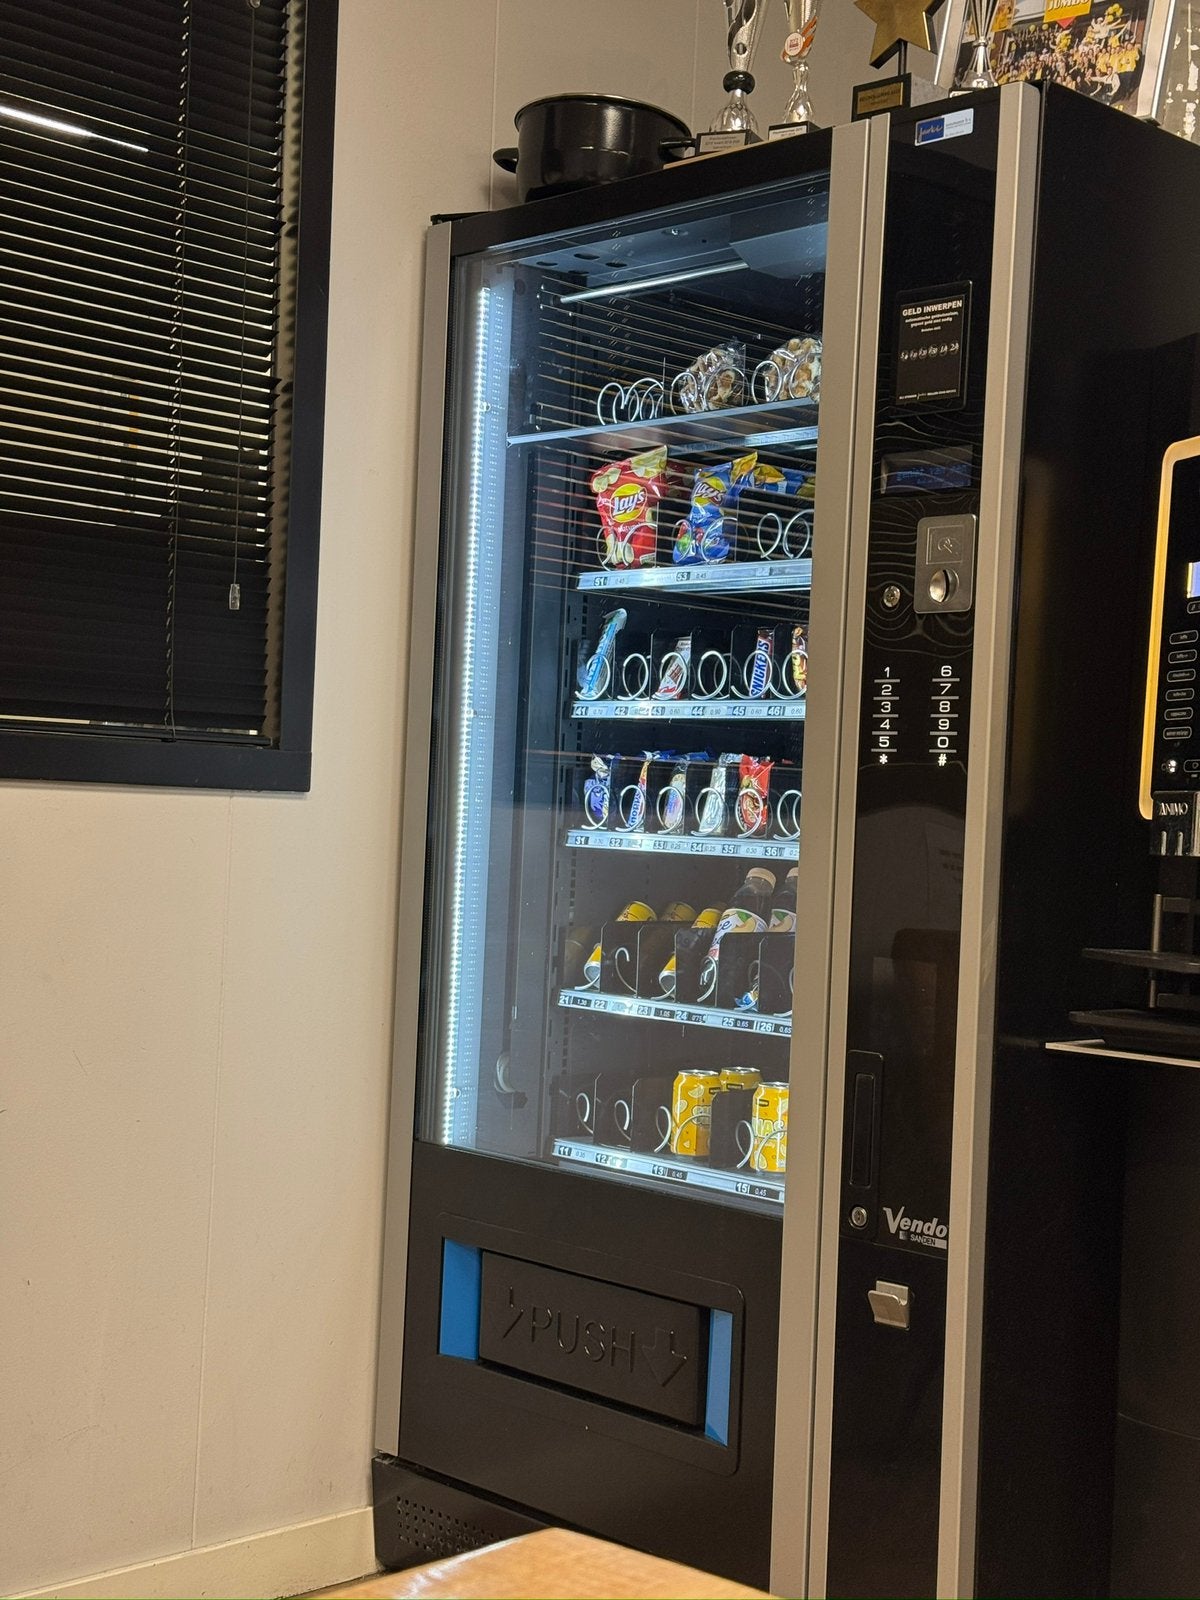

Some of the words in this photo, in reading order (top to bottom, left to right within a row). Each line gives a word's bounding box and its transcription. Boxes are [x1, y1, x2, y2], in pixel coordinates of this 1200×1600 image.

[902, 306, 922, 316] GELD
[923, 299, 963, 313] INWERPEN
[612, 489, 645, 516] Lay's
[749, 639, 770, 697] SNICKES
[884, 666, 890, 678] 1
[940, 665, 952, 677] 6
[881, 684, 892, 695] 2
[940, 683, 952, 695] 7
[692, 706, 703, 715] 44
[733, 706, 745, 716] 45
[768, 706, 780, 716] 46
[881, 701, 891, 713] 3
[939, 701, 951, 713] 8
[880, 719, 890, 730] 4
[938, 719, 950, 730] 9
[879, 736, 890, 748] 5
[937, 736, 949, 748] 0
[1160, 802, 1189, 816] ANIMO
[610, 838, 621, 847] 32
[654, 840, 665, 850] 33
[691, 842, 702, 852] 34
[722, 844, 734, 854] 35
[765, 847, 777, 857] 36
[560, 995, 570, 1005] 21
[595, 1000, 605, 1010] 22
[638, 1005, 649, 1015] 23
[676, 1010, 688, 1021] 24
[722, 1017, 735, 1027] 25
[761, 1022, 773, 1032] 26
[559, 1146, 570, 1156] 11
[597, 1154, 608, 1164] 12
[653, 1164, 664, 1175] 13
[736, 1182, 748, 1194] 15
[882, 1206, 948, 1238] Vendo
[531, 1304, 636, 1374] PUSH
